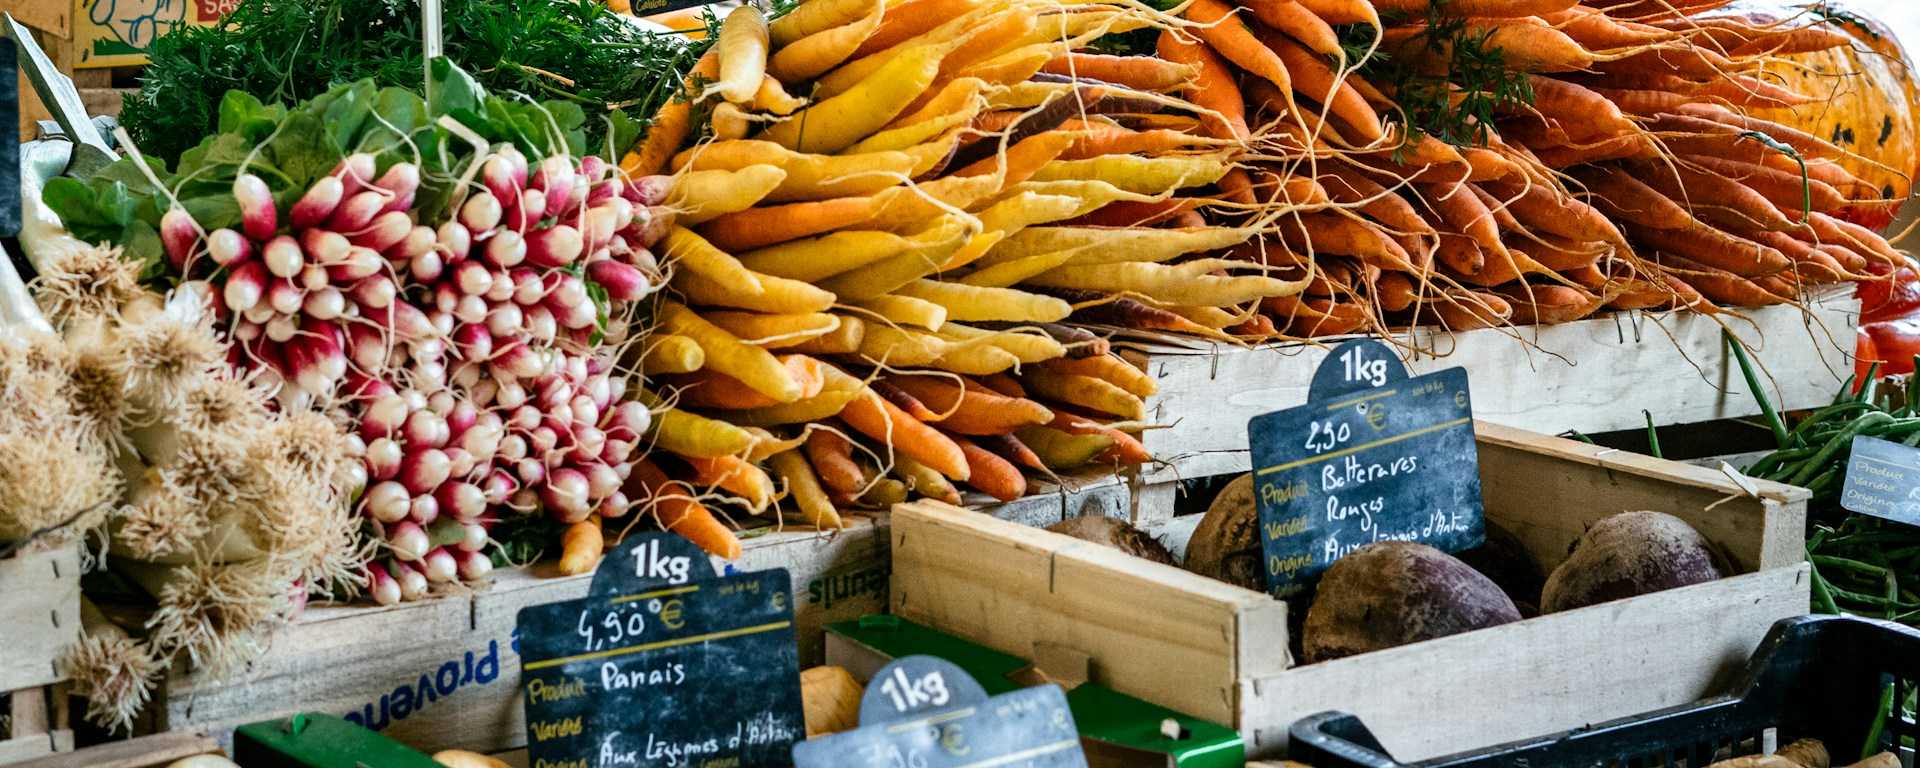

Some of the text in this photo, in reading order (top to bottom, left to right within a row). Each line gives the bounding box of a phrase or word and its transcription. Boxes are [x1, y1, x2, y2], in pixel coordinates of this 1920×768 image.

[1339, 346, 1387, 387] 1kg
[1305, 421, 1351, 453] 2,90
[631, 539, 690, 584] 1kg
[601, 661, 685, 691] Panais
[881, 667, 949, 712] 1kg
